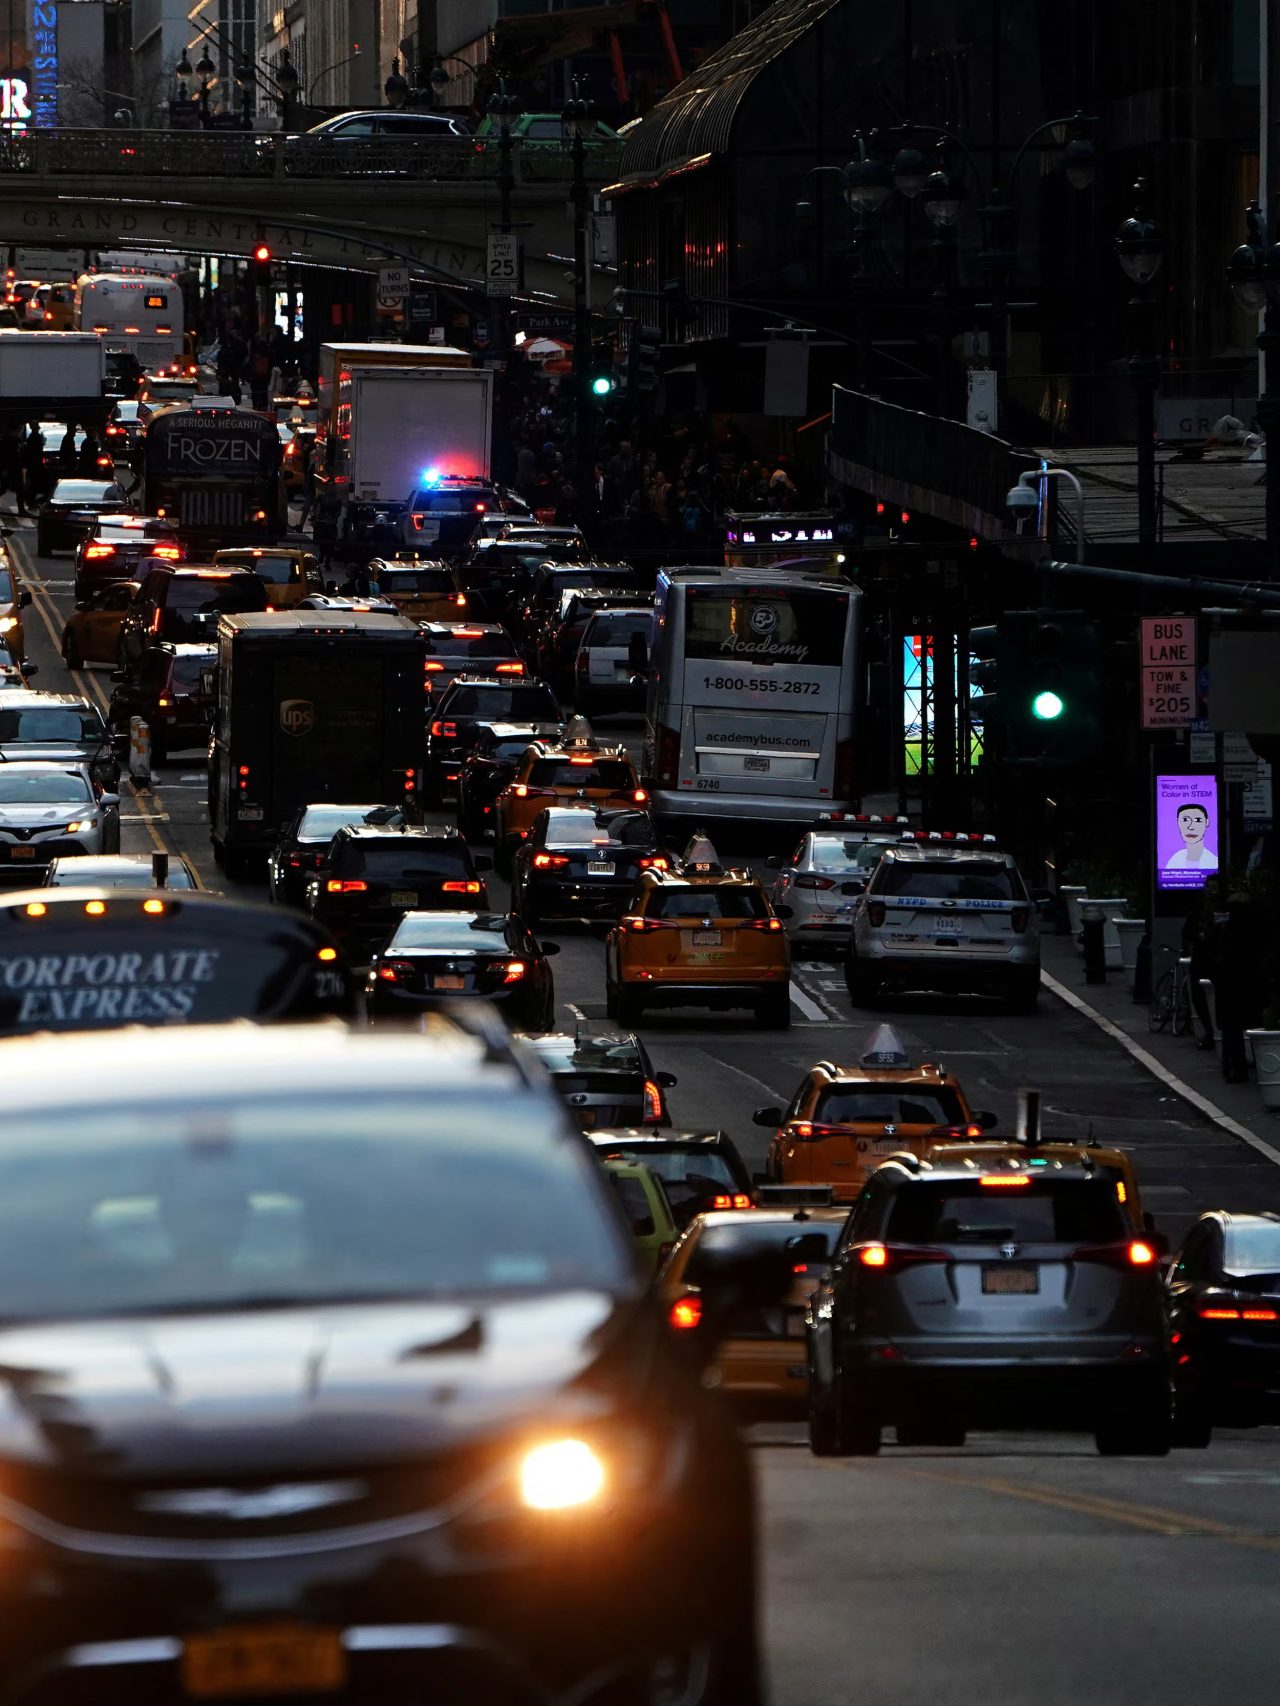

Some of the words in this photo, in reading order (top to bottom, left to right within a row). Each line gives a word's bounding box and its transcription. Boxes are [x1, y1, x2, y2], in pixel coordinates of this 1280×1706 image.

[23, 210, 138, 231] GRAND
[162, 217, 313, 248] CENTRAL
[490, 259, 515, 276] 25
[387, 271, 401, 281] NO
[381, 283, 409, 293] TURNS
[529, 316, 549, 328] Park
[168, 419, 176, 428] A
[177, 418, 216, 429] SERIOUS
[167, 431, 261, 465] FROZEN
[1154, 623, 1183, 640] BUS
[719, 632, 809, 663] Academy
[1150, 644, 1188, 661] LANE
[1149, 671, 1174, 682] TOW
[1180, 671, 1188, 681] &
[703, 677, 821, 695] 1-800-555-2872
[1156, 683, 1182, 694] FINE
[1149, 697, 1190, 714] $205
[282, 710, 312, 731] ups
[706, 732, 810, 748] academybus.com
[697, 779, 720, 790] 6740
[1162, 783, 1190, 791] Women
[1190, 783, 1199, 791] of
[1162, 791, 1181, 799] Color
[1182, 790, 1190, 798] in
[1190, 790, 1213, 798] STEM
[897, 897, 927, 906] NYPD
[965, 899, 1005, 909] POLICE
[18, 984, 196, 1022] EXPRESS
